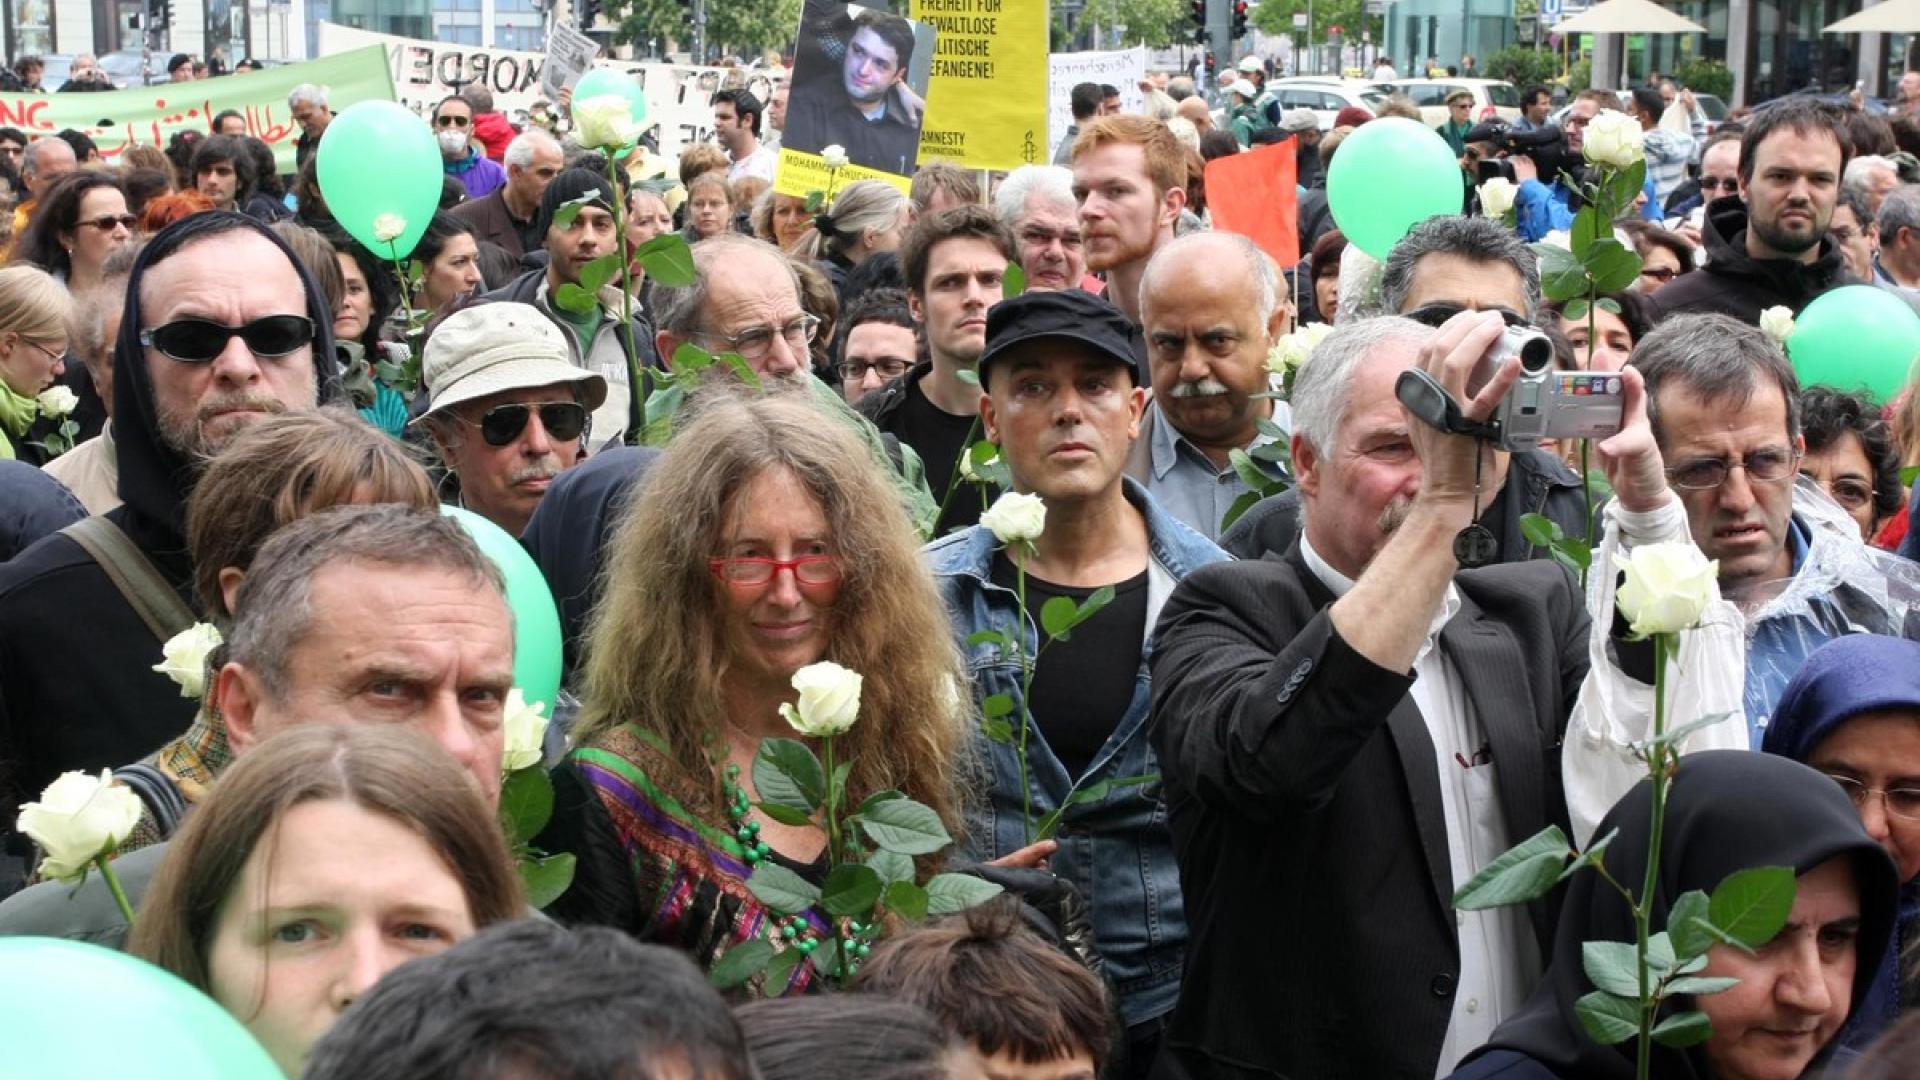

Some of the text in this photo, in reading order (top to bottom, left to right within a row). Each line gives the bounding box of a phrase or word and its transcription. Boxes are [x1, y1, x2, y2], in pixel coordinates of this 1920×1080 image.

[920, 0, 972, 12] FREIHEIT
[1545, 0, 1559, 13] U
[933, 38, 990, 56] LITISCHE
[929, 60, 994, 79] EFANGENE!
